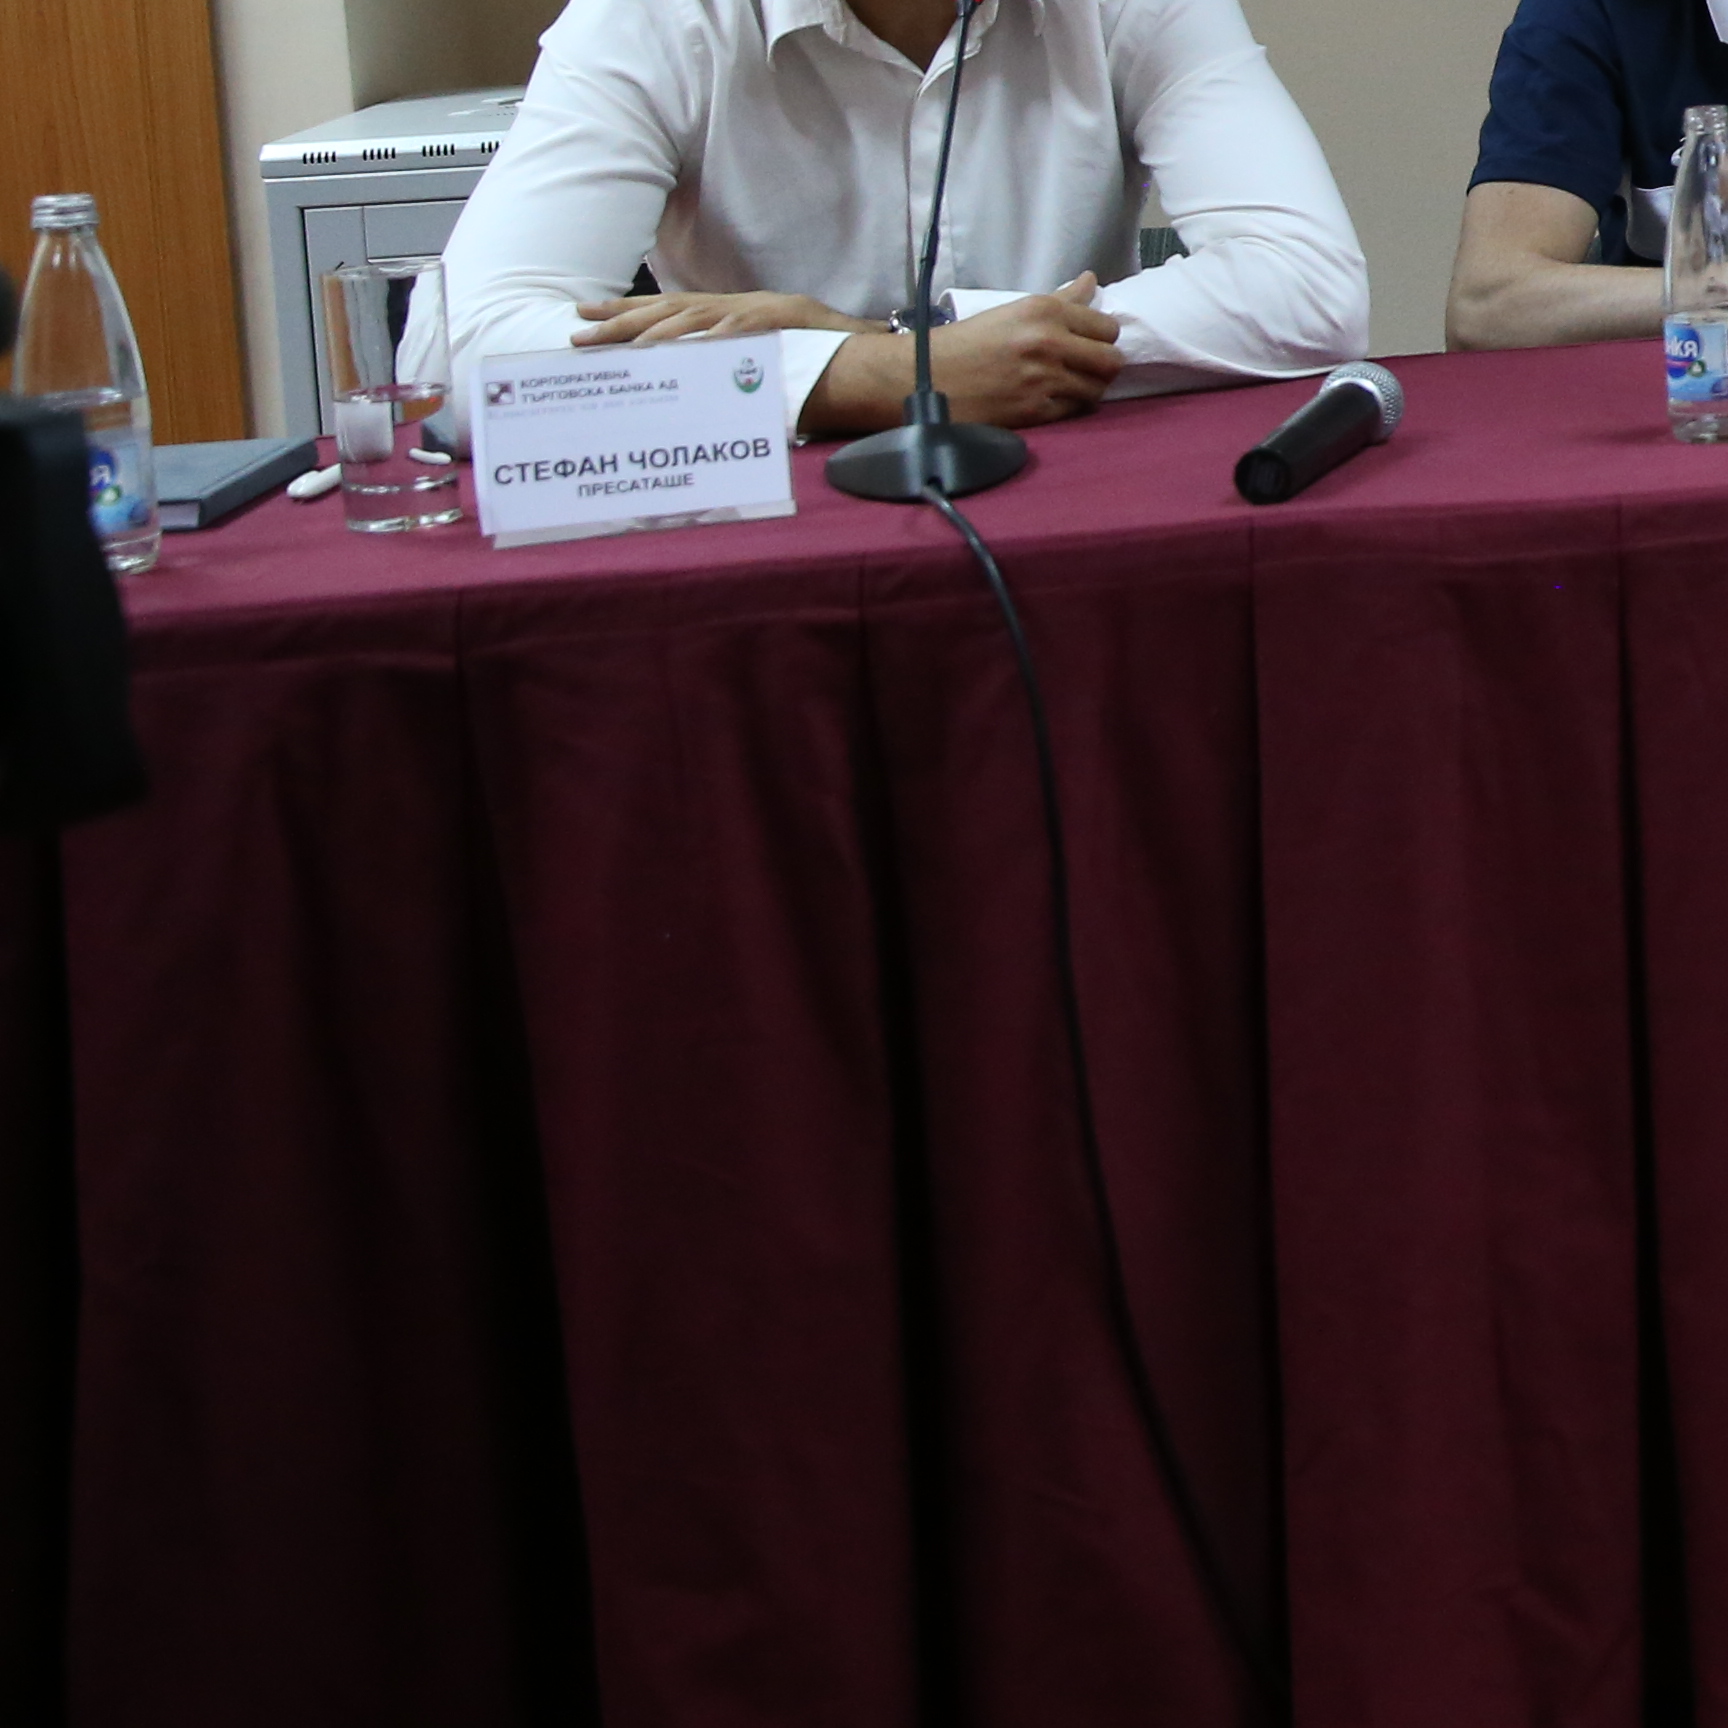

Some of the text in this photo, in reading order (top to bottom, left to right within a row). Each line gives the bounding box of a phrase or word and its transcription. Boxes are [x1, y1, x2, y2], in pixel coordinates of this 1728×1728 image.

[659, 378, 680, 391] АД
[494, 437, 772, 485] СТЕФАН ЧОЛАКОВ
[578, 473, 695, 498] ПРЕСАТАШЕ
